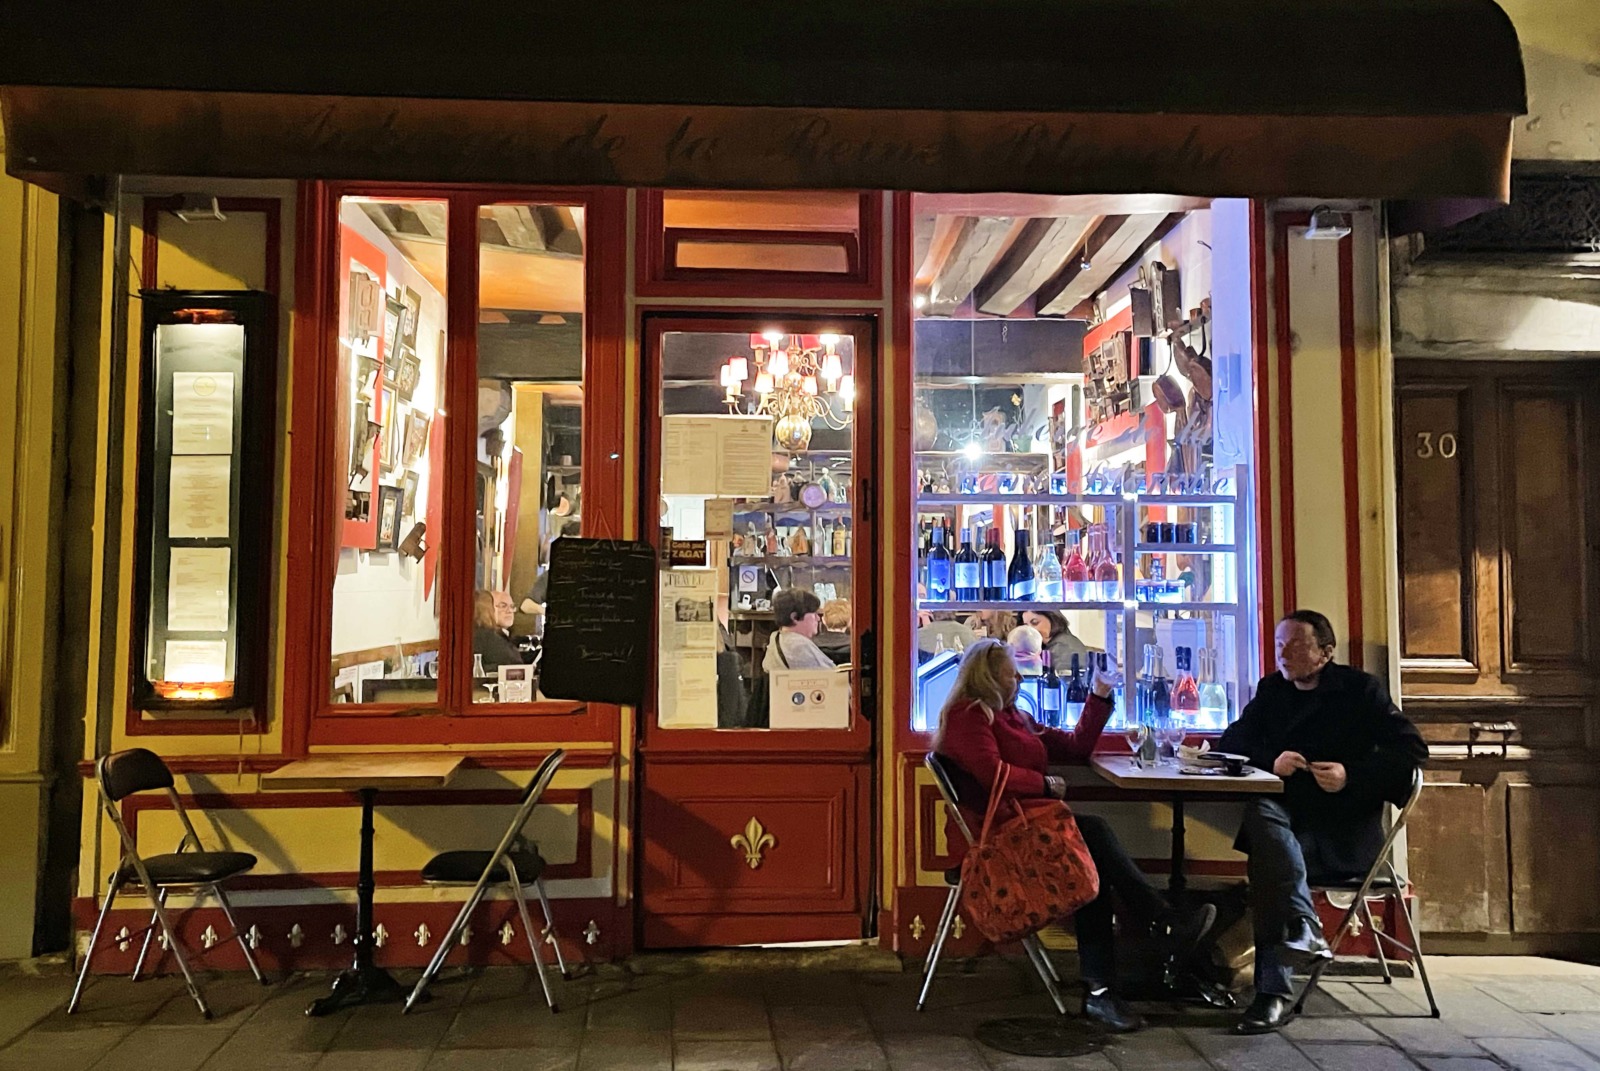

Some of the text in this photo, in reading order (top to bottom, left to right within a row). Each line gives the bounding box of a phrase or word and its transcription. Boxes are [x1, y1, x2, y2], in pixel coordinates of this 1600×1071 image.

[558, 112, 626, 161] de
[664, 115, 722, 163] la
[766, 115, 944, 167] Reine
[1416, 432, 1457, 459] 30
[671, 550, 706, 558] ZAGAT
[666, 573, 705, 586] TRAVEL
